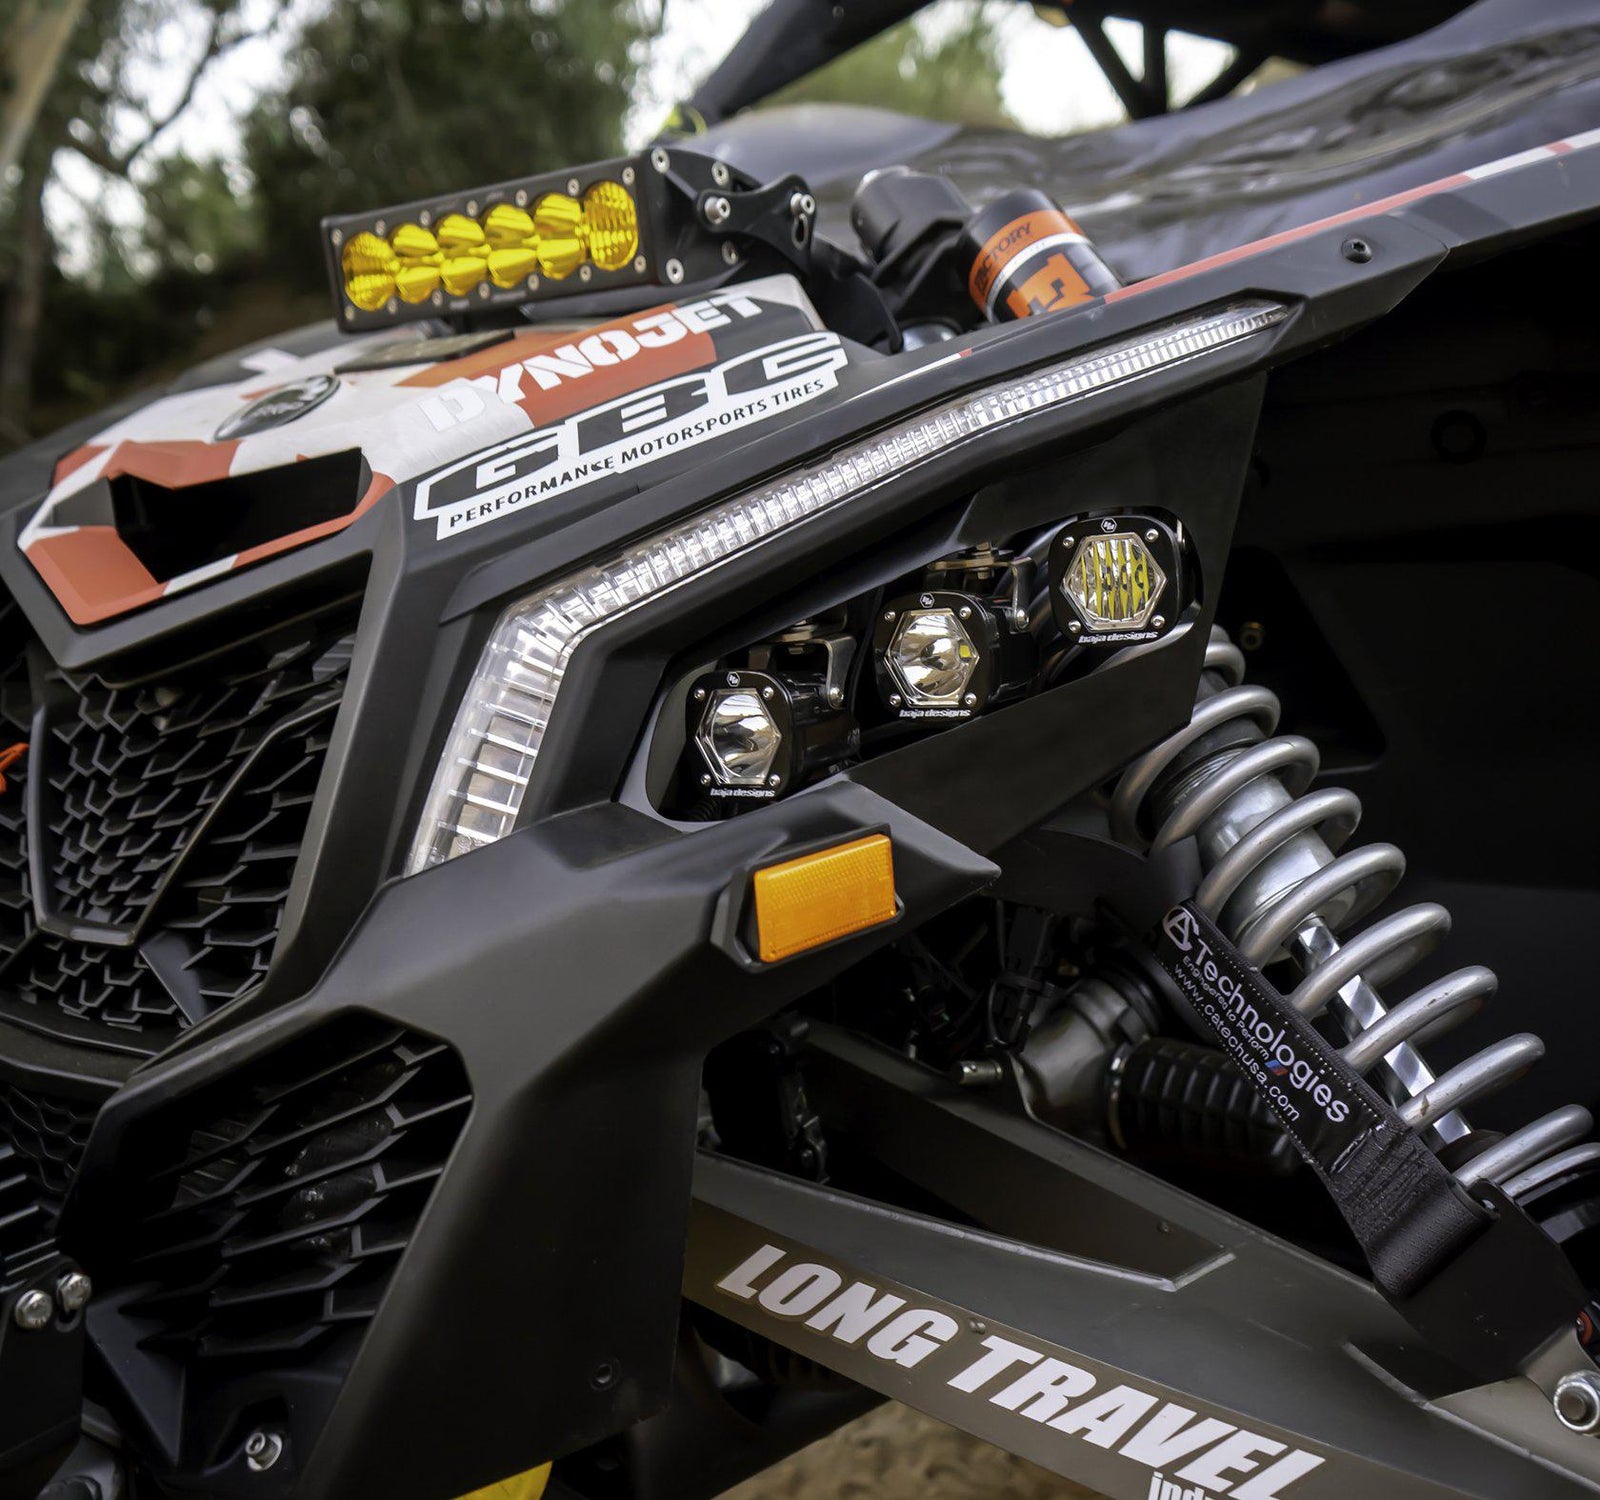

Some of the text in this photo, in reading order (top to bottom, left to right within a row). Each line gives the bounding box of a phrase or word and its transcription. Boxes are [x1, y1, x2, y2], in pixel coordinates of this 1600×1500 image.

[417, 293, 763, 432] DYNOJET
[449, 377, 825, 527] PERFORMANCE MOTORSPORTS TIRES
[1106, 631, 1159, 642] designs
[733, 788, 776, 798] designs
[1174, 964, 1301, 1122] www.catechusa.com
[1195, 938, 1350, 1123] Technologies
[1226, 1009, 1237, 1021] to
[1236, 1020, 1270, 1061] Perform
[717, 1244, 1326, 1500] LONG TRAVEL
